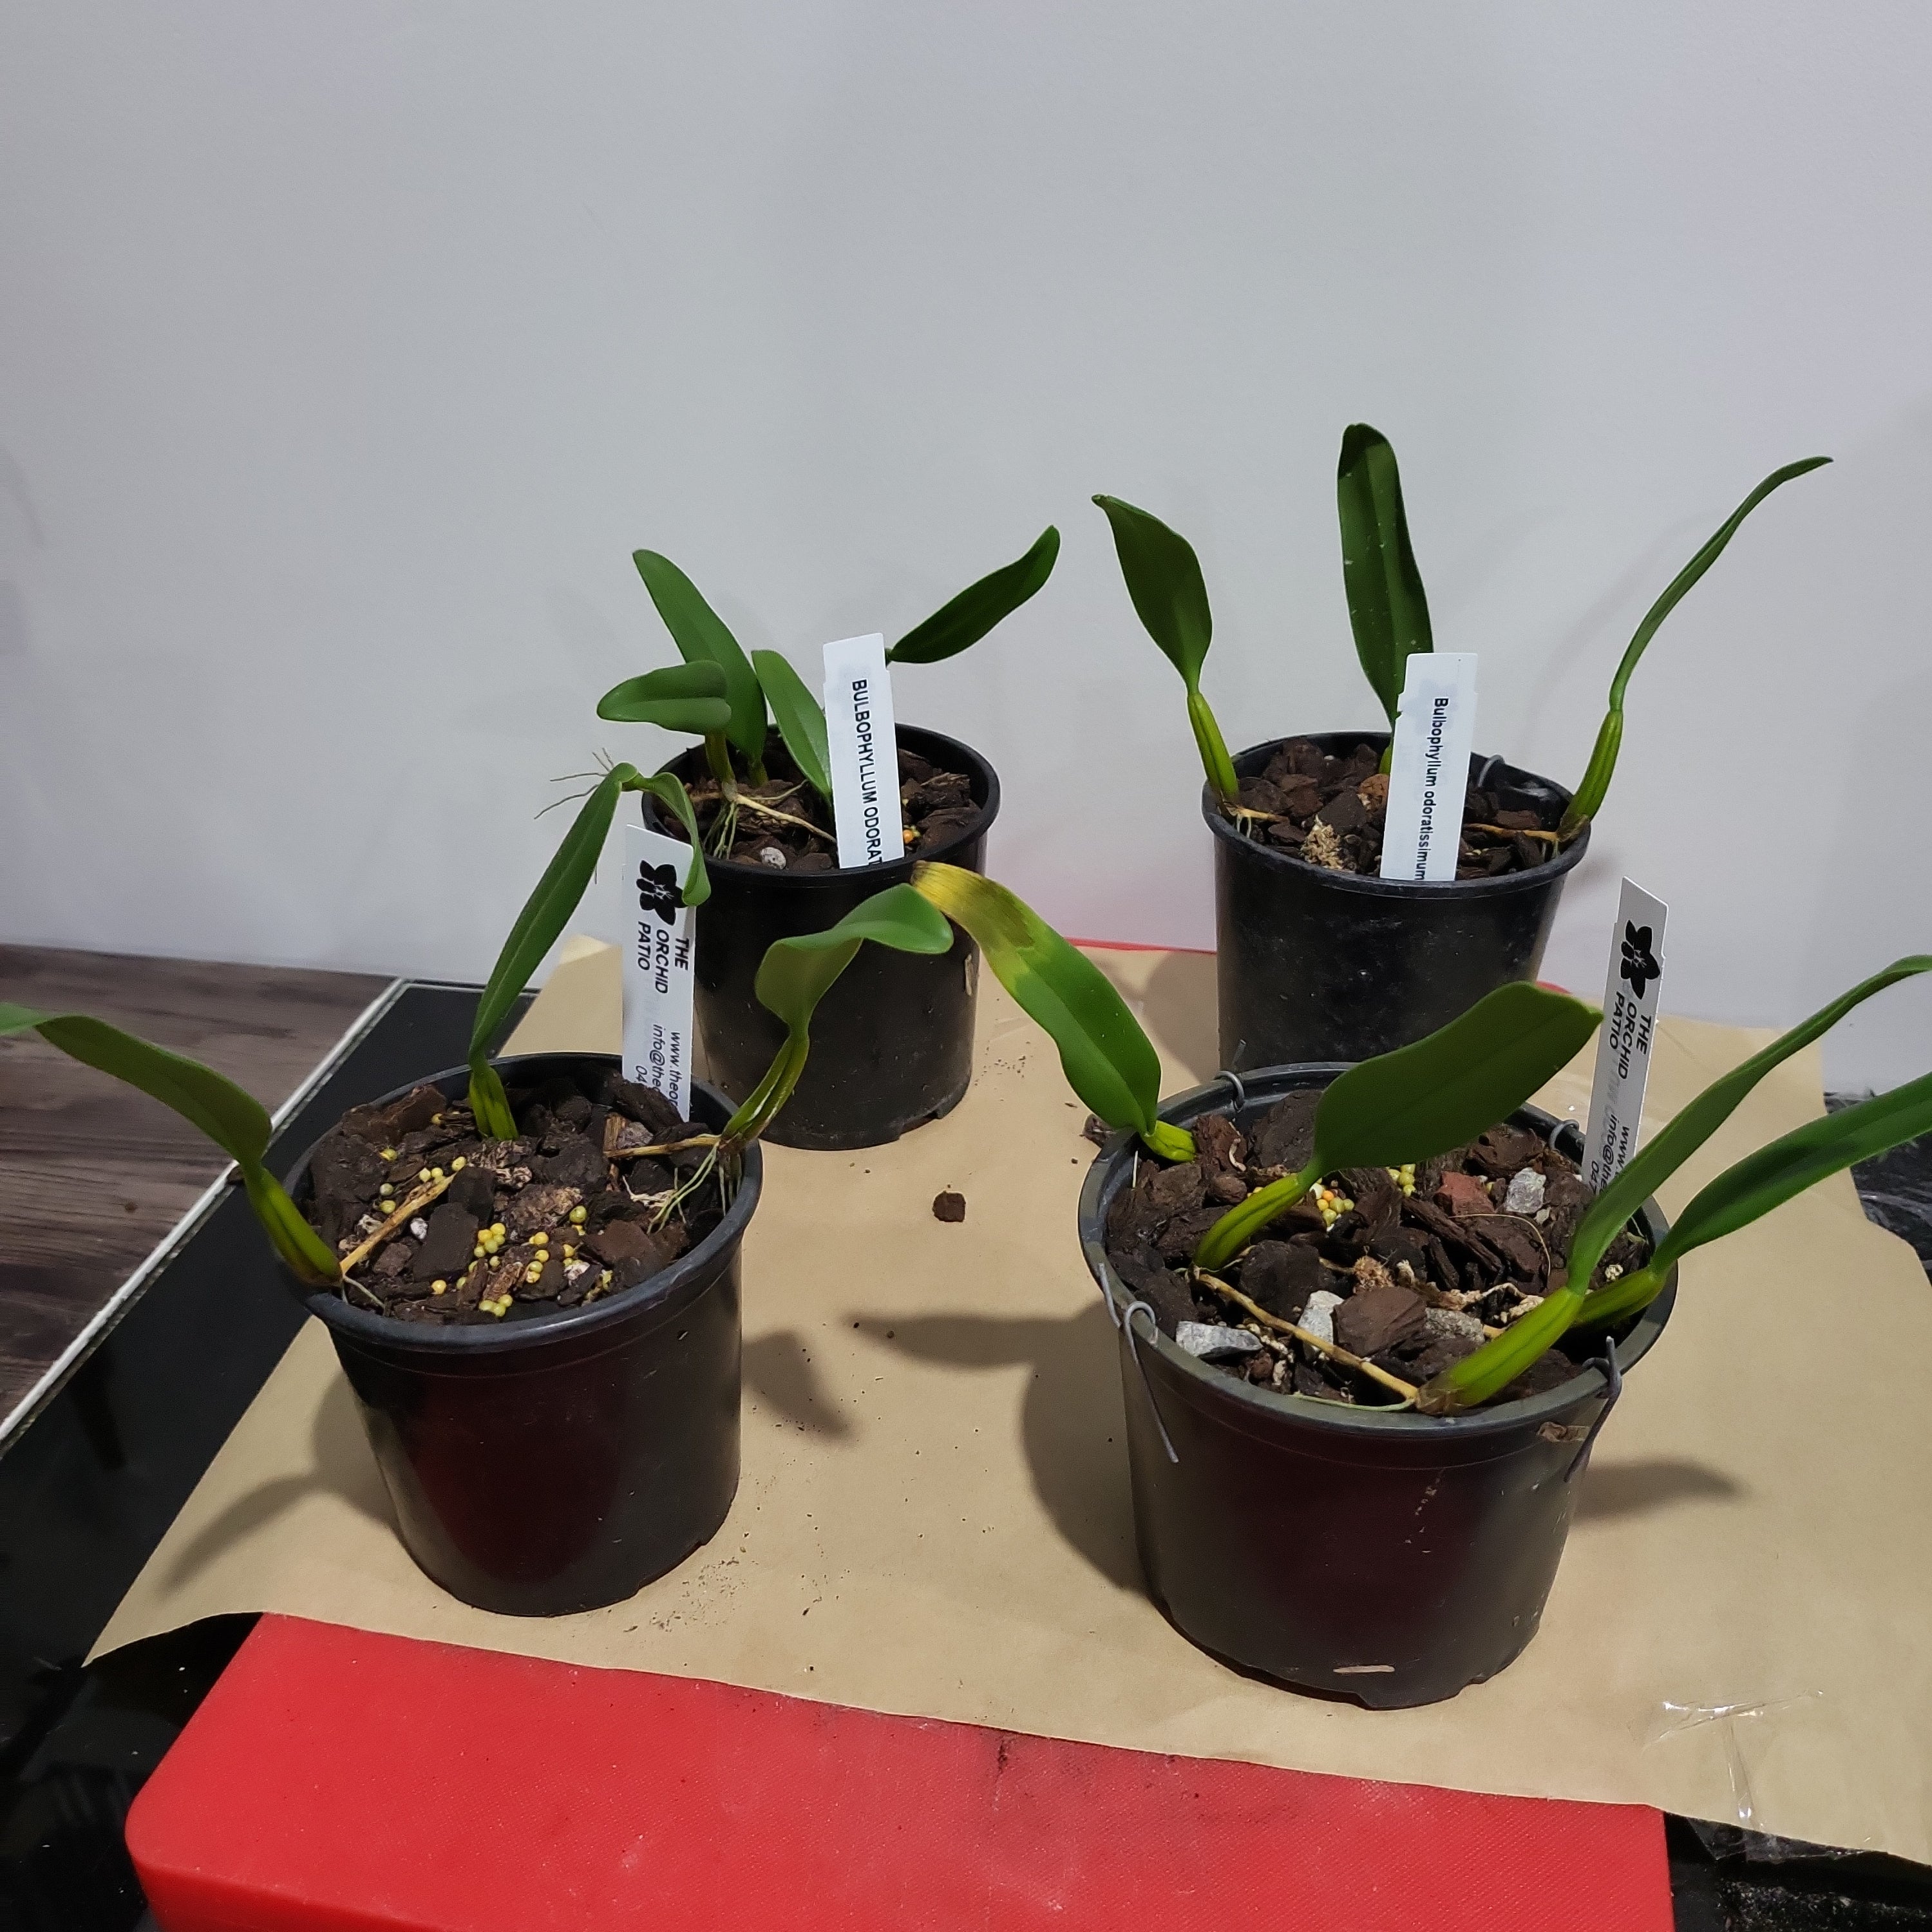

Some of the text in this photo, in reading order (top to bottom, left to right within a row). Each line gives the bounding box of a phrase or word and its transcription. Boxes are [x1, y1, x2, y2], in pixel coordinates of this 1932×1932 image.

[852, 679, 877, 804] BULBOPHYLLUM
[1414, 697, 1448, 880] Bulbophyllum odoratissimum
[638, 921, 651, 971] PATIO
[656, 929, 669, 994] ORCHID
[675, 938, 689, 971] THE
[1610, 991, 1624, 1049] PATIO
[1618, 1002, 1636, 1079] ORCHID
[1636, 1015, 1652, 1054] THE
